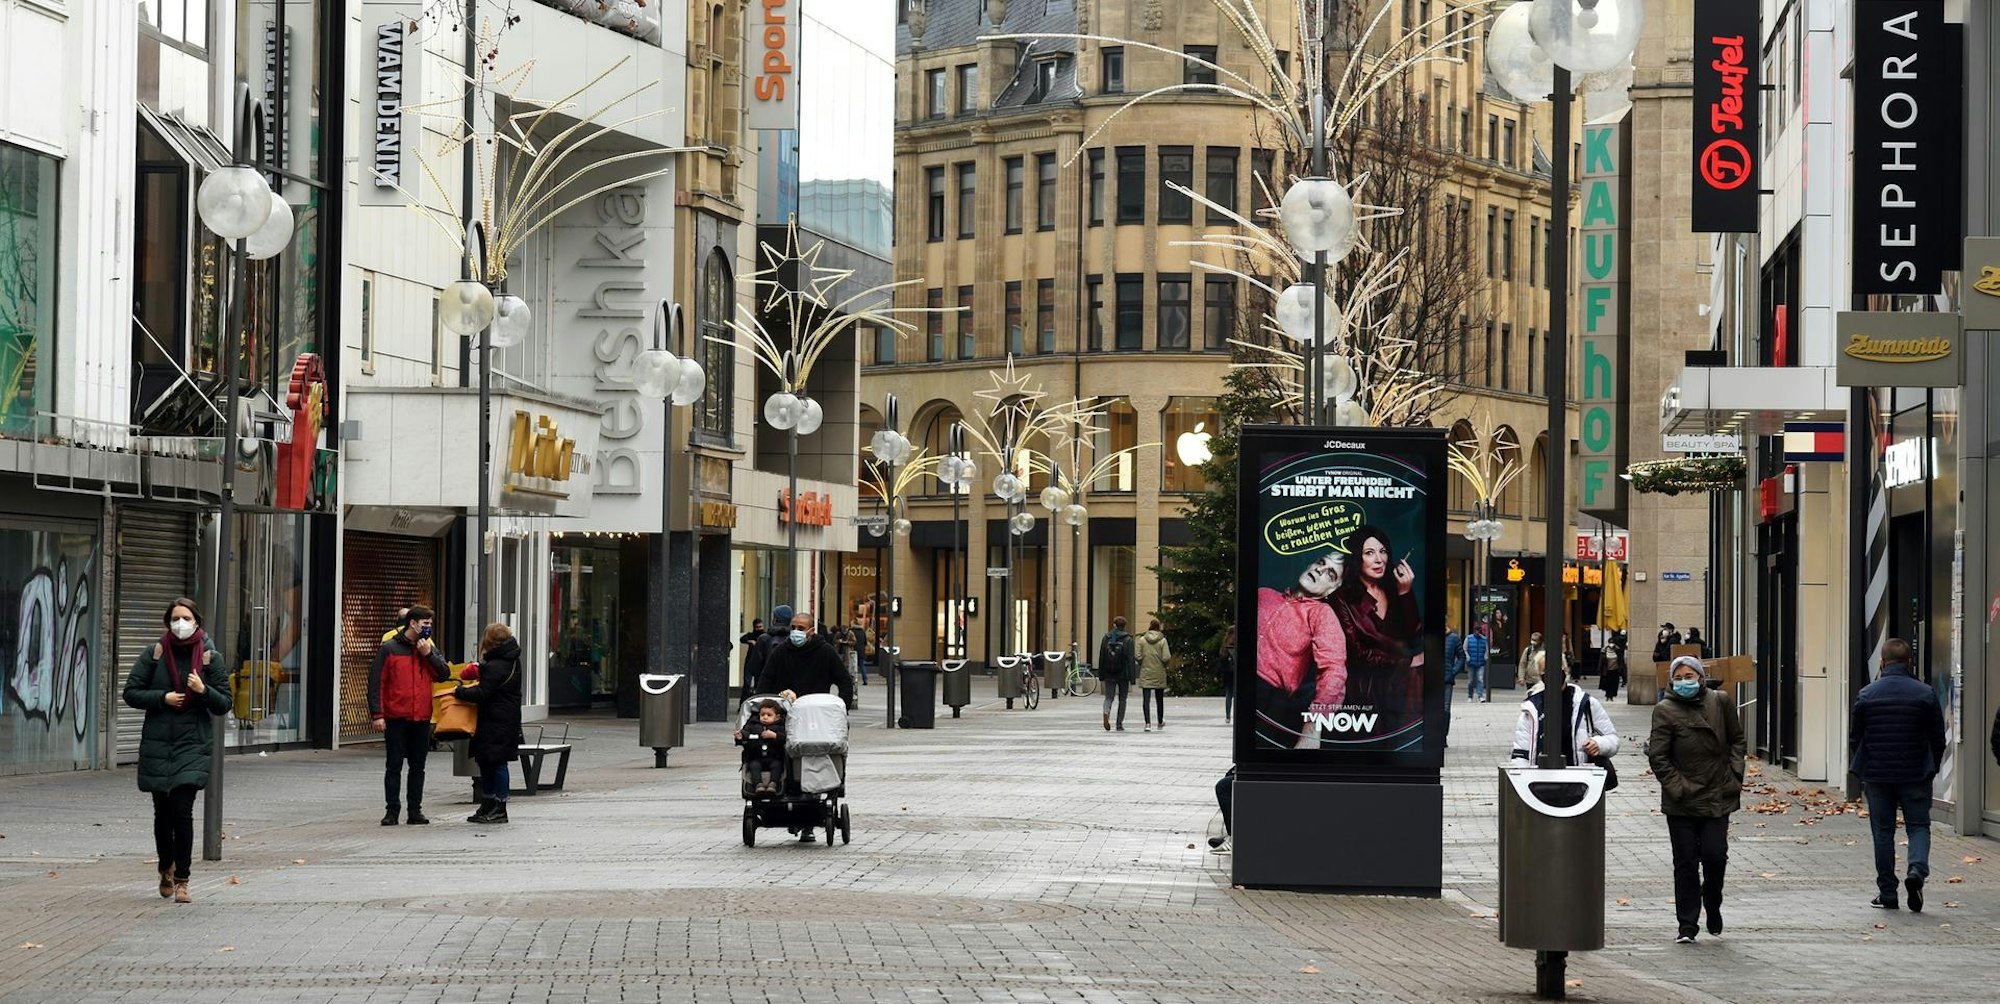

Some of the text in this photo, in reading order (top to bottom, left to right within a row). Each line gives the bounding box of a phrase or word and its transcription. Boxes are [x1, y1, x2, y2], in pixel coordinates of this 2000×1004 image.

[1711, 35, 1749, 134] Teufel
[1880, 11, 1919, 283] SEPHORA
[577, 186, 647, 496] Bershka
[1844, 334, 1952, 361] Zumnorde
[1324, 440, 1366, 450] JCDecaux
[1666, 441, 1735, 449] BEAUTY SPA
[1295, 476, 1392, 486] UNTER FREUNDEN
[1271, 484, 1415, 499] STIRBT MAN NICHT
[1279, 504, 1346, 527] Warum ins Gras
[1306, 520, 1332, 532] wenn
[1334, 516, 1349, 525] man
[1280, 543, 1290, 551] es
[1291, 531, 1333, 549] rauchen
[1301, 712, 1379, 733] TVNOW
